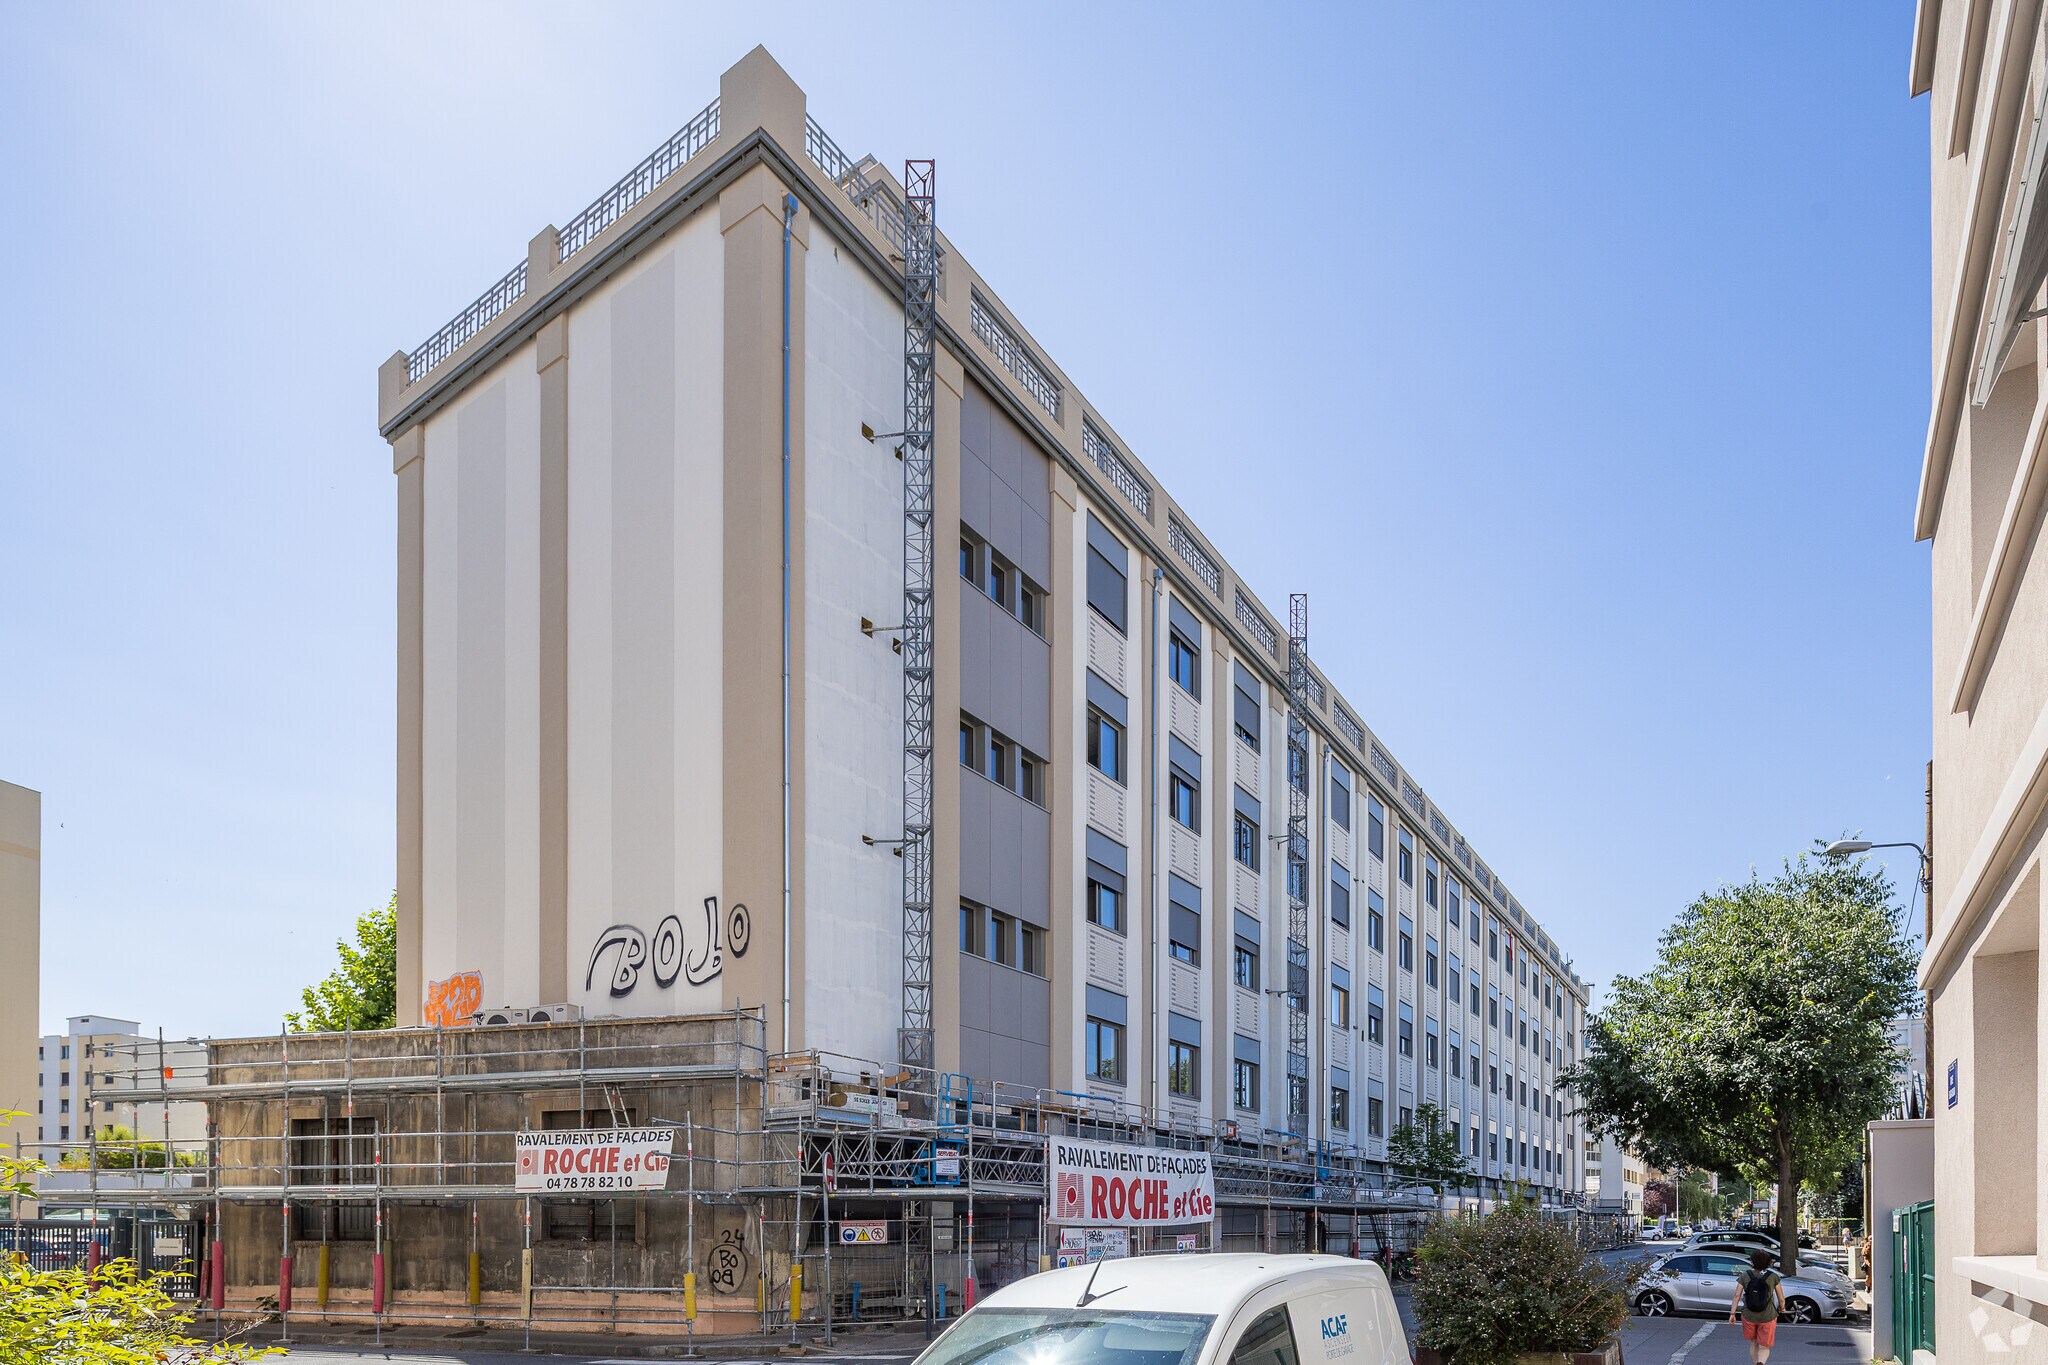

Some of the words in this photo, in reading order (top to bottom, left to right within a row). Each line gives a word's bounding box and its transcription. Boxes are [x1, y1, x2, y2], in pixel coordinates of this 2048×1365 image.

[516, 1133, 594, 1146] RAVALEMENT
[597, 1132, 613, 1144] DE
[616, 1130, 672, 1145] FAÇADES
[543, 1147, 620, 1175] ROCHE
[623, 1153, 640, 1172] et
[643, 1151, 669, 1172] Cie
[1057, 1145, 1143, 1172] RAVALEMENT
[1147, 1155, 1161, 1173] DE
[1161, 1157, 1207, 1179] FAÇADES
[546, 1178, 561, 1189] 04
[563, 1177, 578, 1189] 78
[580, 1177, 595, 1188] 78
[598, 1176, 614, 1188] 82
[618, 1176, 633, 1187] 10
[1091, 1175, 1169, 1220] ROCHE
[1173, 1191, 1187, 1218] et
[1189, 1187, 1213, 1217] Cie
[721, 1228, 745, 1251] 24
[1321, 1314, 1347, 1340] ACAF
